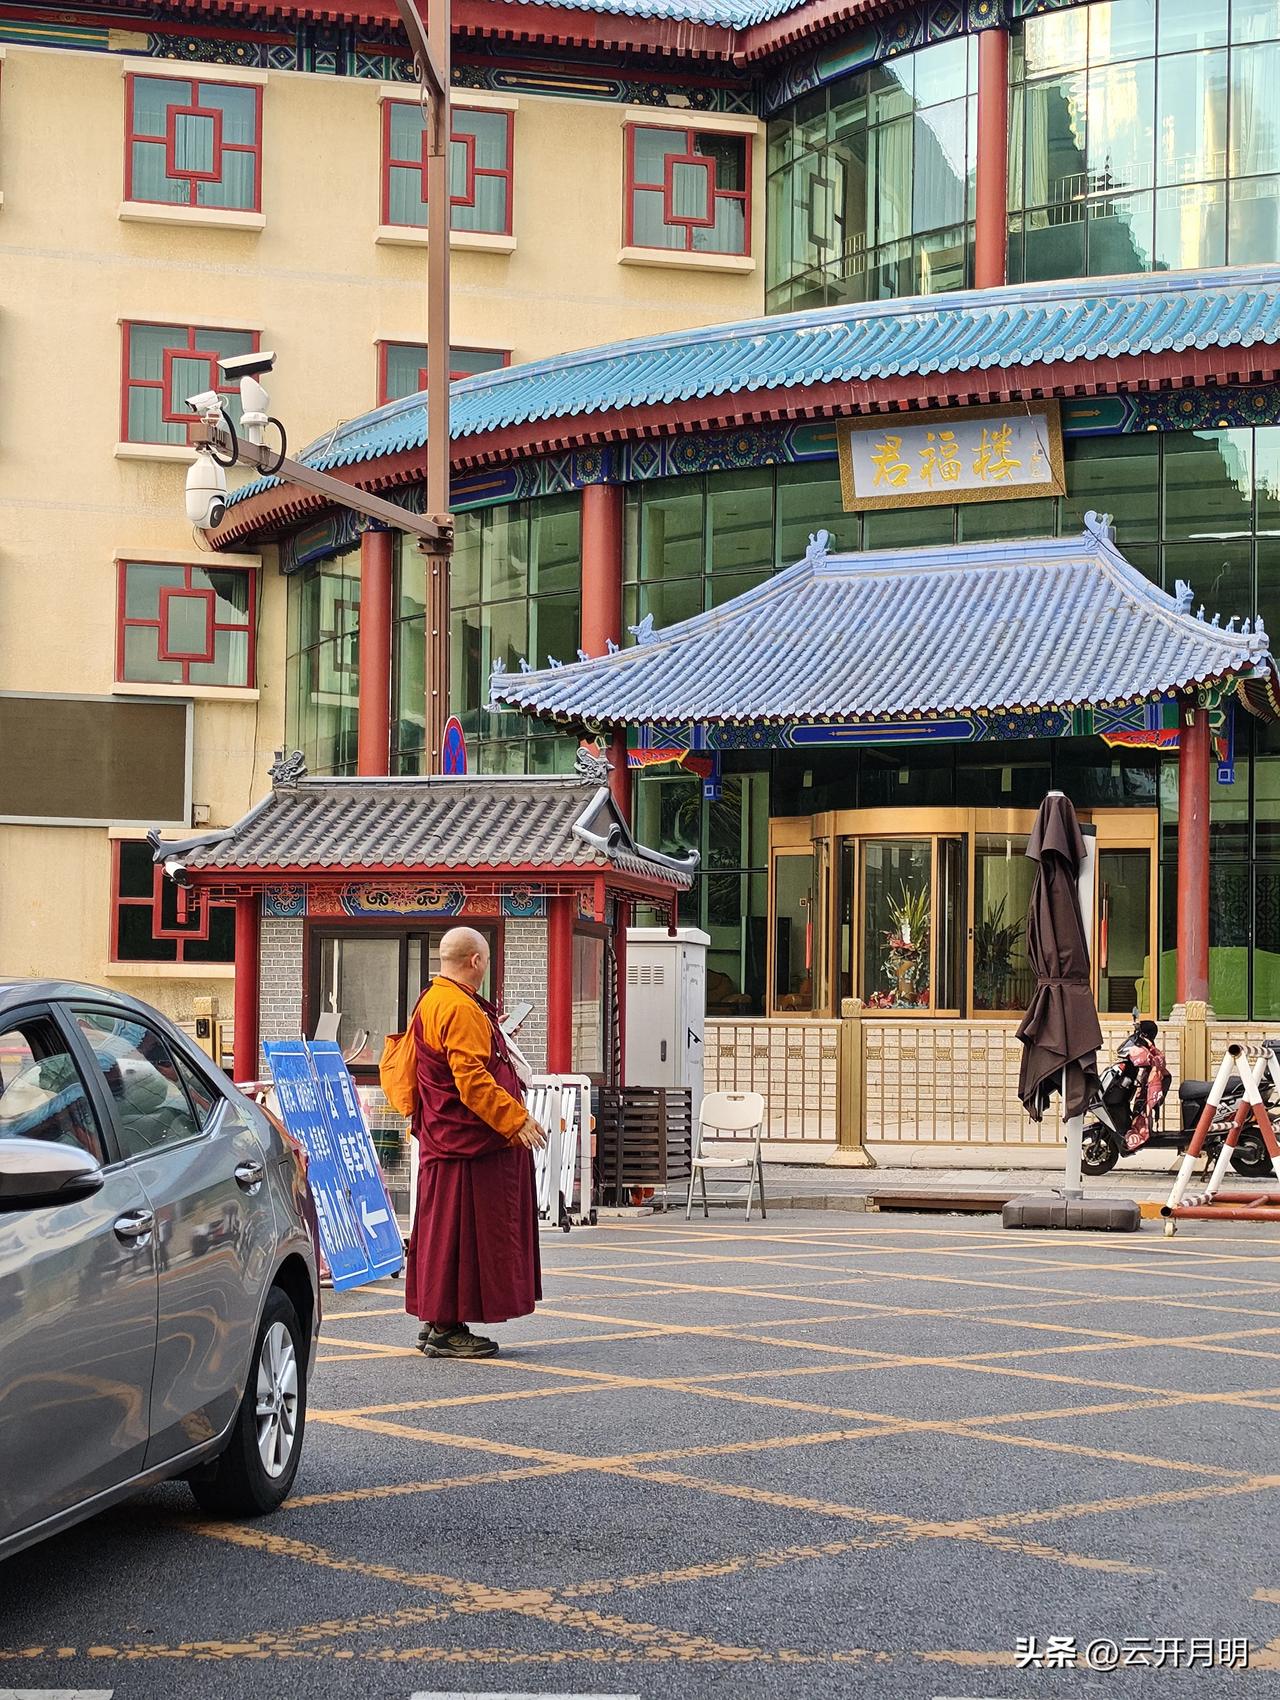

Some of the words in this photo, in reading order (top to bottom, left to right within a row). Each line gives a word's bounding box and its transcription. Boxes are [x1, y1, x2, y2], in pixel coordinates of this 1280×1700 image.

[870, 423, 1022, 488] 君福楼
[337, 1130, 375, 1184] 停车场
